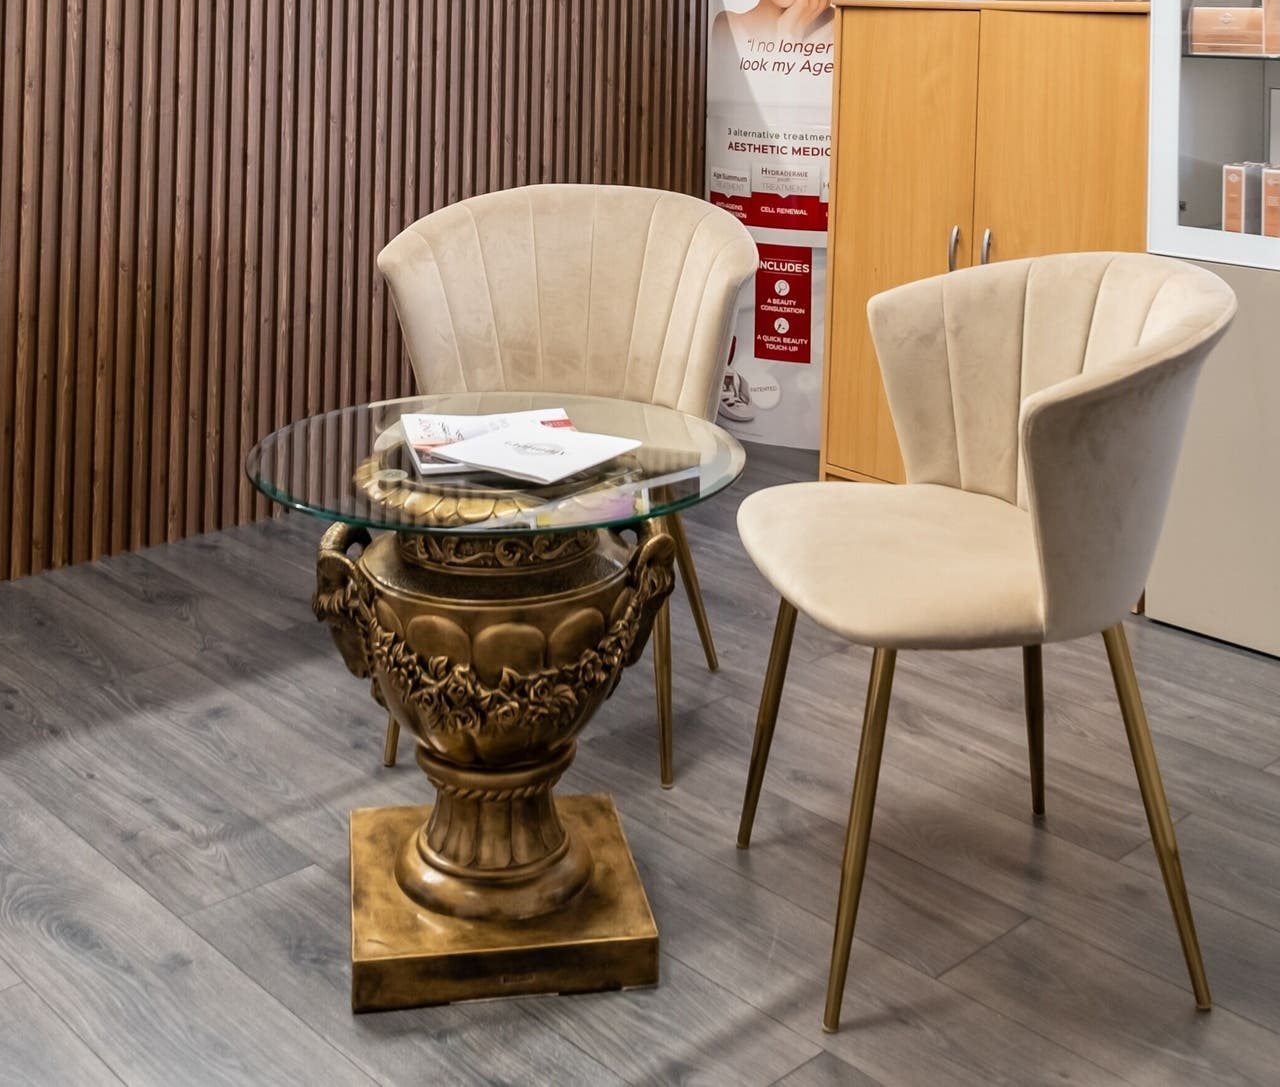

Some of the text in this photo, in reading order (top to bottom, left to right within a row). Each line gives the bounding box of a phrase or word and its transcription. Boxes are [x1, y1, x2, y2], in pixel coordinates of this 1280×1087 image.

[758, 41, 775, 52] no
[778, 39, 833, 57] longer
[739, 57, 833, 76] look my Age
[727, 127, 732, 135] 3
[733, 128, 780, 140] alternative
[727, 141, 788, 156] AESTHETIC
[761, 167, 808, 178] HYDRADERMIE
[761, 182, 808, 192] TREATMENT
[760, 206, 808, 216] CELL RENEWAL
[759, 260, 810, 273] NCLUDES
[772, 298, 797, 306] BEAUTY
[760, 304, 805, 314] CONSULTATION
[762, 335, 782, 343] QUICK
[782, 337, 809, 345] BEAUTY
